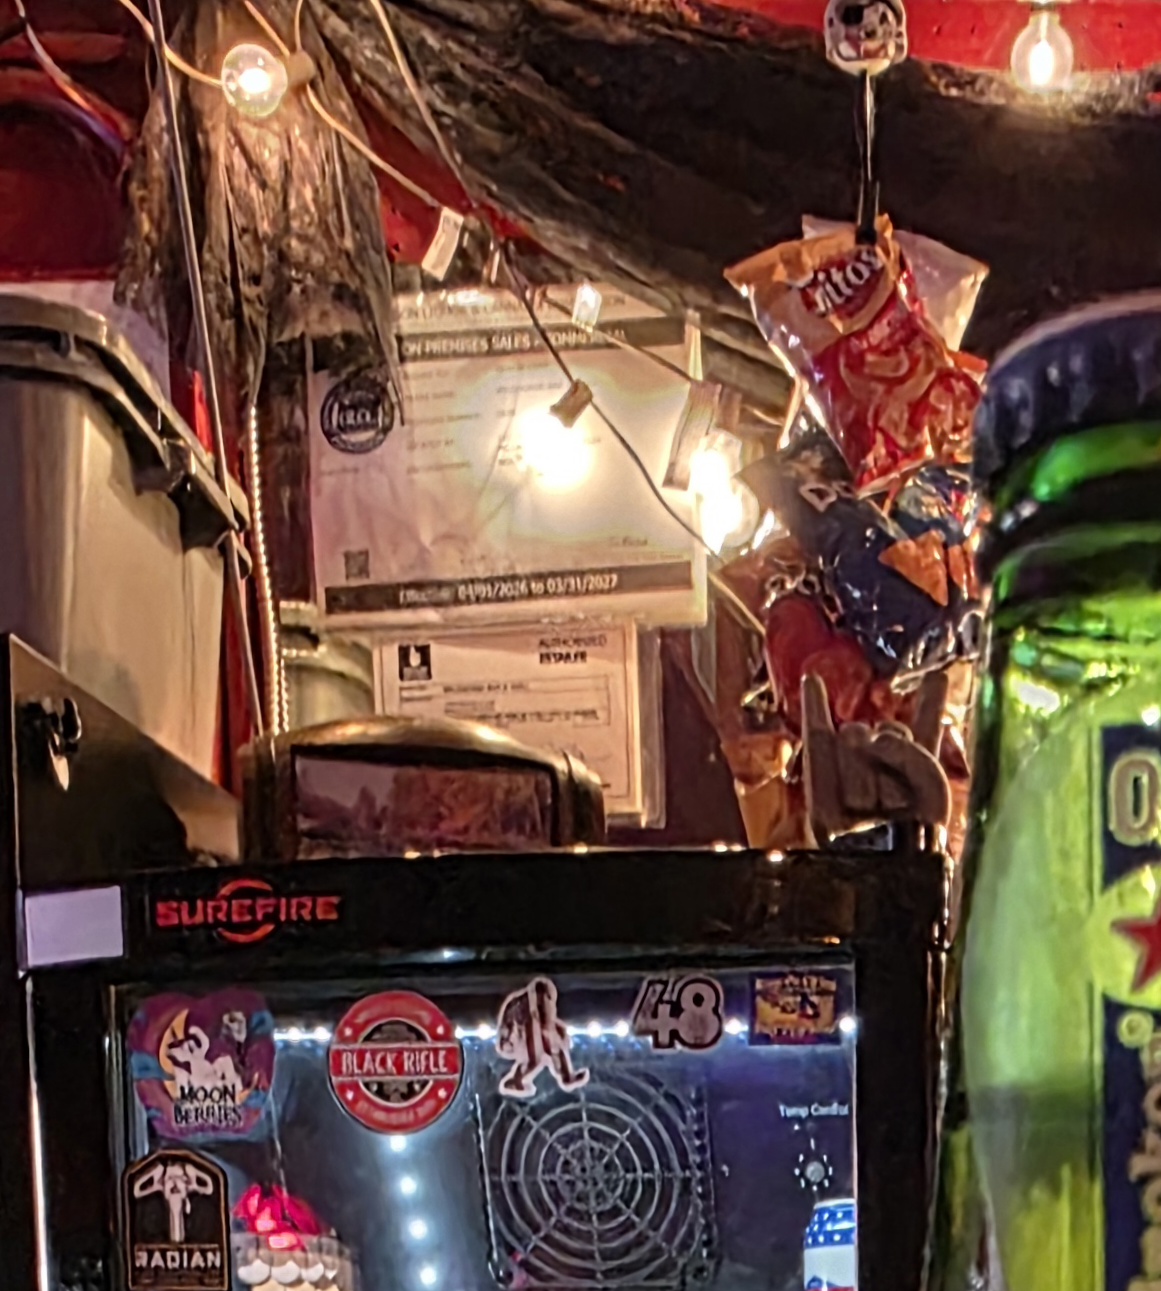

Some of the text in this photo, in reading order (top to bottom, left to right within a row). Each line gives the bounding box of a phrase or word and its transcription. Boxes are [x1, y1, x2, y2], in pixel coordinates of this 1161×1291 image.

[811, 248, 886, 317] ritos
[156, 896, 341, 928] SUREFIRE
[634, 978, 722, 1050] 48
[341, 1048, 449, 1075] BLACK RIFLE
[178, 1083, 237, 1102] MOON
[134, 1250, 221, 1271] RADIAN
